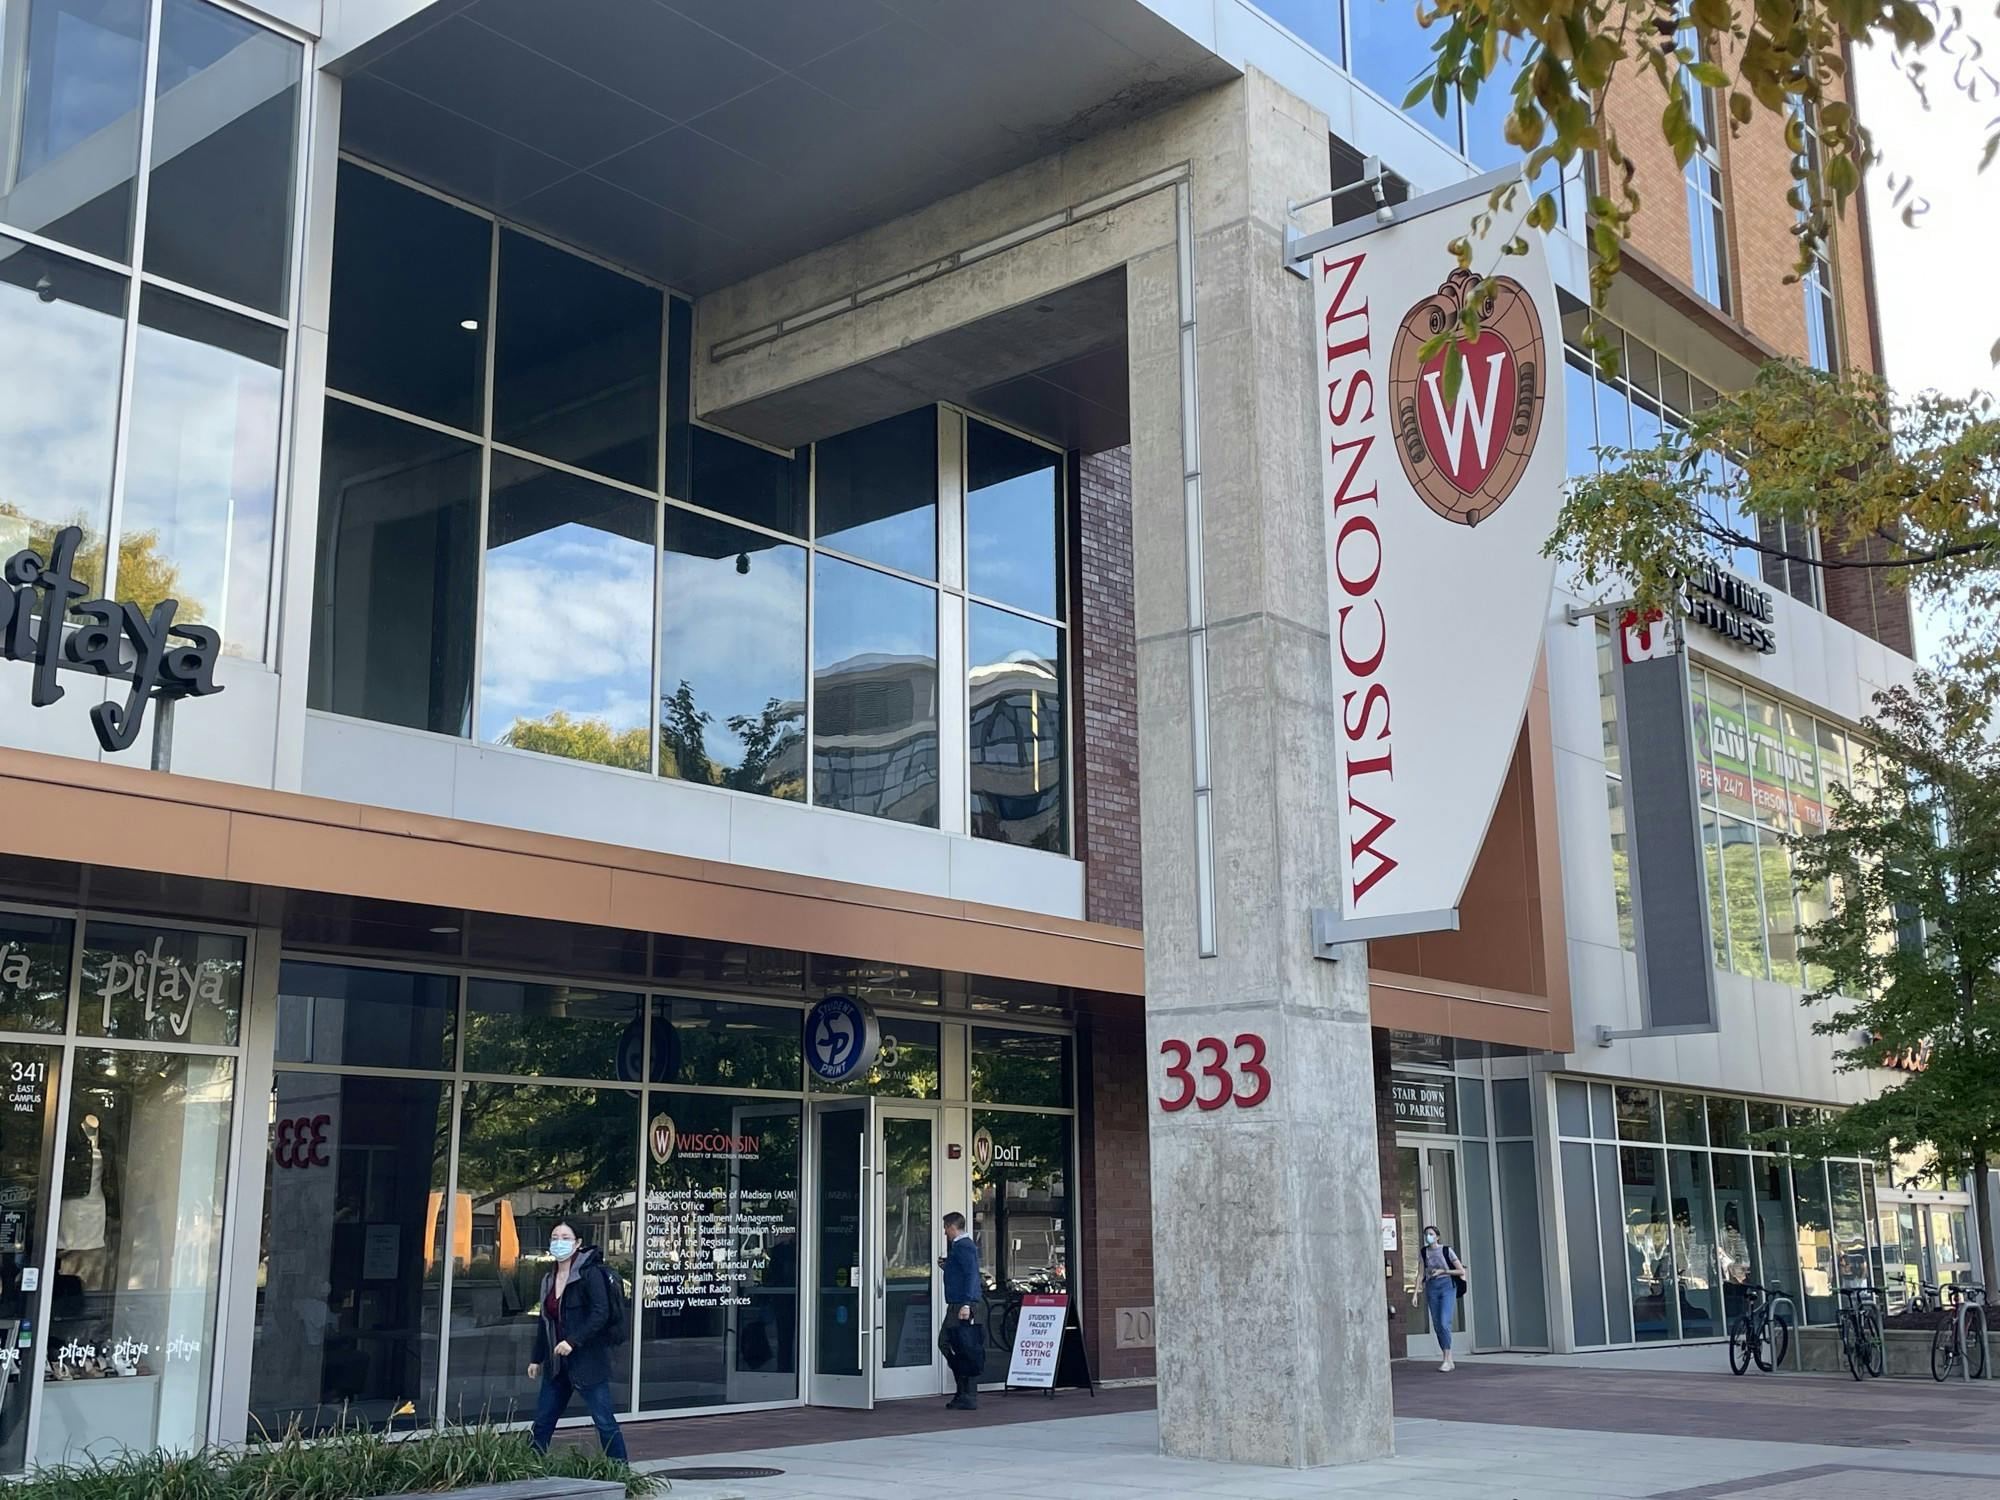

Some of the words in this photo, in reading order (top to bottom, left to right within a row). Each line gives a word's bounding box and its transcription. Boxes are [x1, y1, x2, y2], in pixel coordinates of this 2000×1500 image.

[1423, 352, 1506, 477] W
[1322, 252, 1399, 910] WISCONSIN
[1690, 596, 1777, 656] FITNESS
[1713, 716, 1815, 789] ANYTIME
[1723, 775, 1744, 797] 24/7
[97, 936, 224, 1036] pitaya
[817, 1000, 855, 1020] STUDENT
[10, 1061, 45, 1082] 341
[819, 1061, 847, 1077] PRINT
[1158, 1033, 1272, 1113] 333
[17, 1084, 35, 1093] EAST
[1392, 1087, 1417, 1101] STAIR
[1420, 1089, 1445, 1103] DOWN
[8, 1093, 42, 1103] CAMPUS
[14, 1103, 35, 1112] MALL
[1394, 1102, 1406, 1115] TO
[1409, 1103, 1445, 1118] PARKING
[676, 1133, 760, 1153] WISCONSIN
[994, 1145, 1021, 1161] DoIT
[648, 1189, 692, 1200] Associated
[694, 1189, 727, 1199] Students
[729, 1190, 737, 1199] of
[740, 1189, 772, 1199] Madison
[774, 1189, 797, 1200] (ASM)
[647, 1201, 679, 1211] Bursar's
[681, 1201, 705, 1211] Office
[647, 1213, 679, 1223] Division
[681, 1213, 690, 1223] of
[692, 1212, 732, 1223] Enrollment
[735, 1213, 784, 1225] Management
[646, 1225, 670, 1235] Office
[683, 1225, 697, 1235] The
[699, 1224, 727, 1235] Student
[728, 1224, 769, 1235] Information
[771, 1224, 796, 1236] System
[646, 1237, 671, 1248] Office
[685, 1237, 698, 1247] the
[700, 1238, 735, 1249] Registrar
[680, 1249, 710, 1261] Activity
[645, 1261, 672, 1271] Office
[673, 1261, 681, 1270] of
[684, 1260, 714, 1270] Student
[716, 1260, 749, 1270] Financial
[752, 1260, 765, 1269] Aid
[688, 1273, 714, 1282] Health
[715, 1272, 747, 1281] Services
[676, 1284, 706, 1295] Student
[709, 1284, 732, 1294] Radio
[644, 1299, 685, 1310] University
[688, 1297, 717, 1307] Veteran
[719, 1296, 751, 1306] Services
[58, 1338, 96, 1368] pitaya
[113, 1336, 149, 1365] pitaya
[166, 1334, 200, 1362] pitaya
[1020, 1340, 1055, 1349] COVID-19
[1020, 1349, 1051, 1358] TESTING
